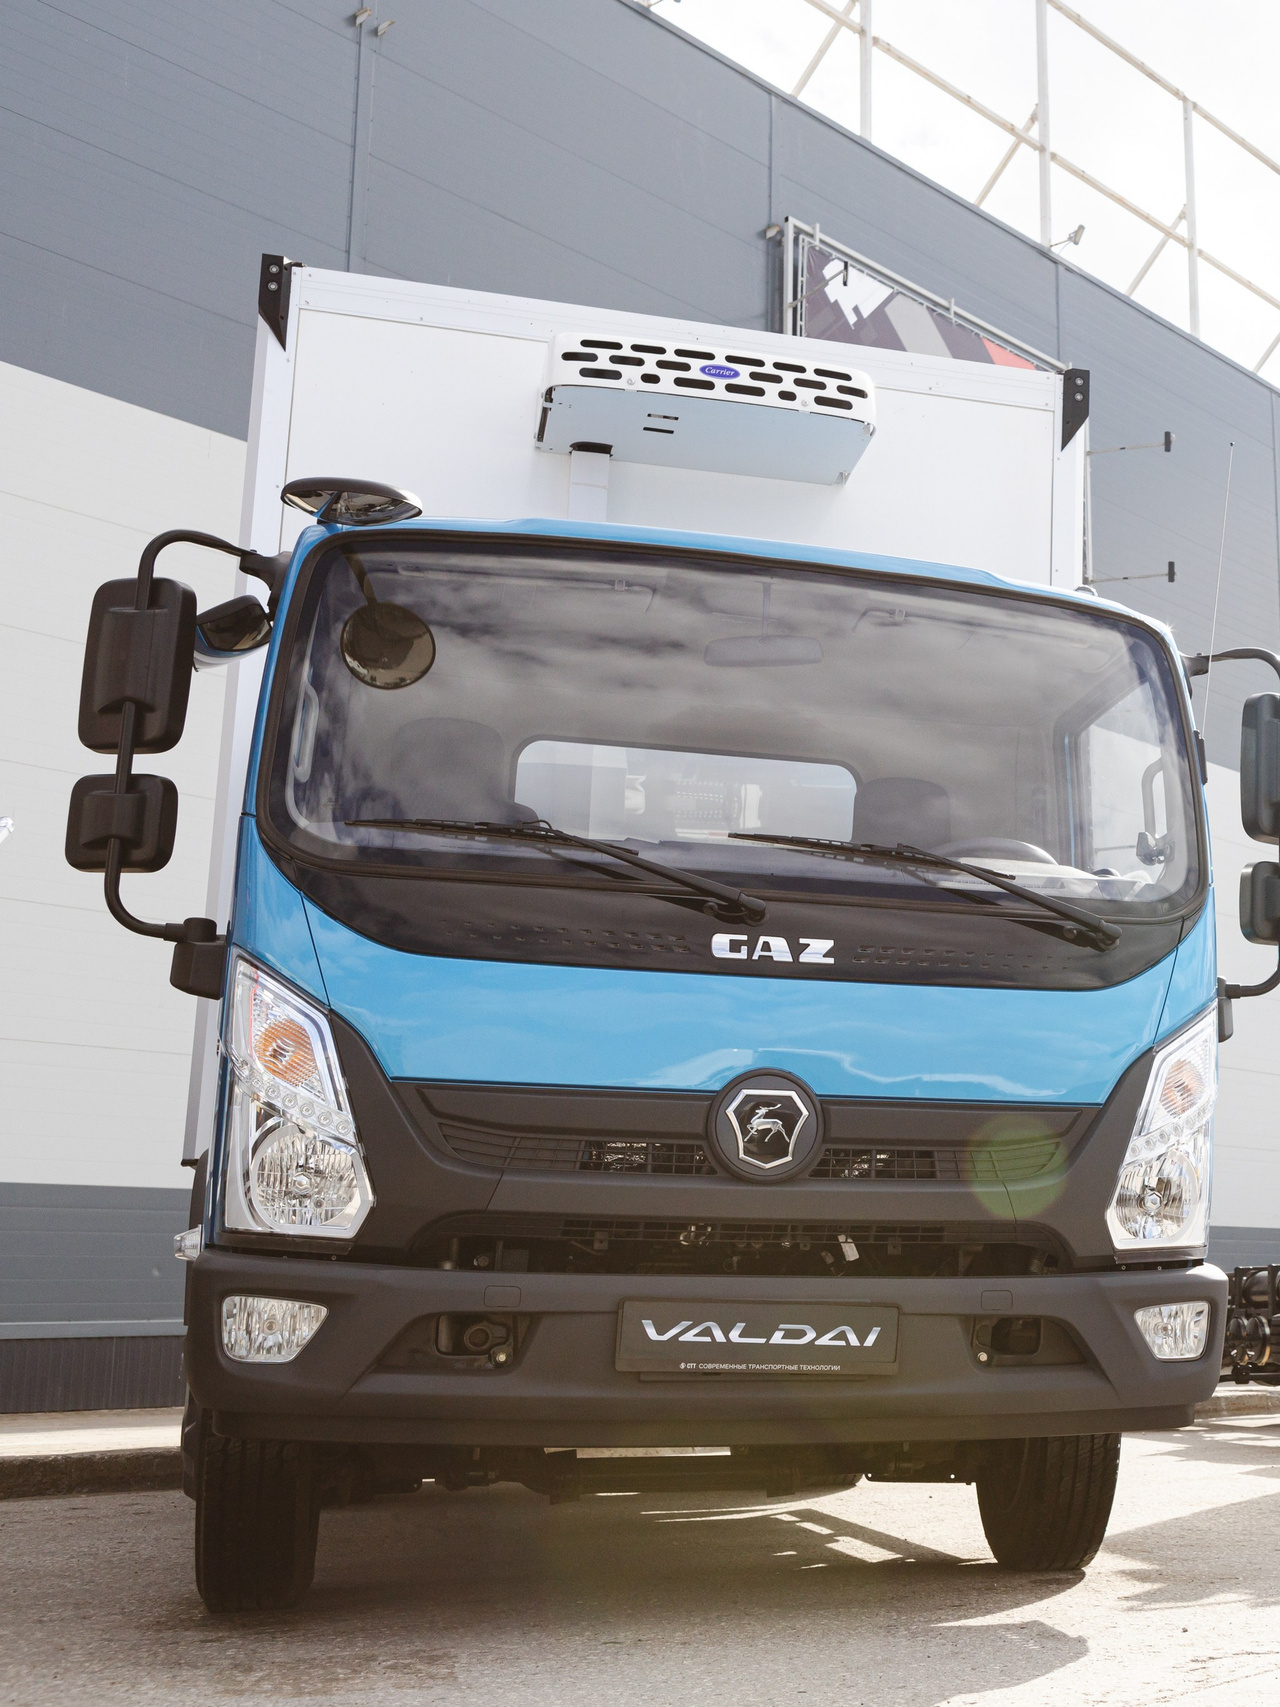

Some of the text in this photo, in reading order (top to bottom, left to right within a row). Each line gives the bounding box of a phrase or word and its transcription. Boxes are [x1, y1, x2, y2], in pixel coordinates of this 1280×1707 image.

[705, 366, 735, 376] Carrier
[711, 933, 835, 964] GAZ
[641, 1319, 882, 1347] VALDAI
[698, 1362, 747, 1370] СОВРЕМЕННЫЕ
[748, 1363, 799, 1371] ТРАНСПОРТНЫЕ
